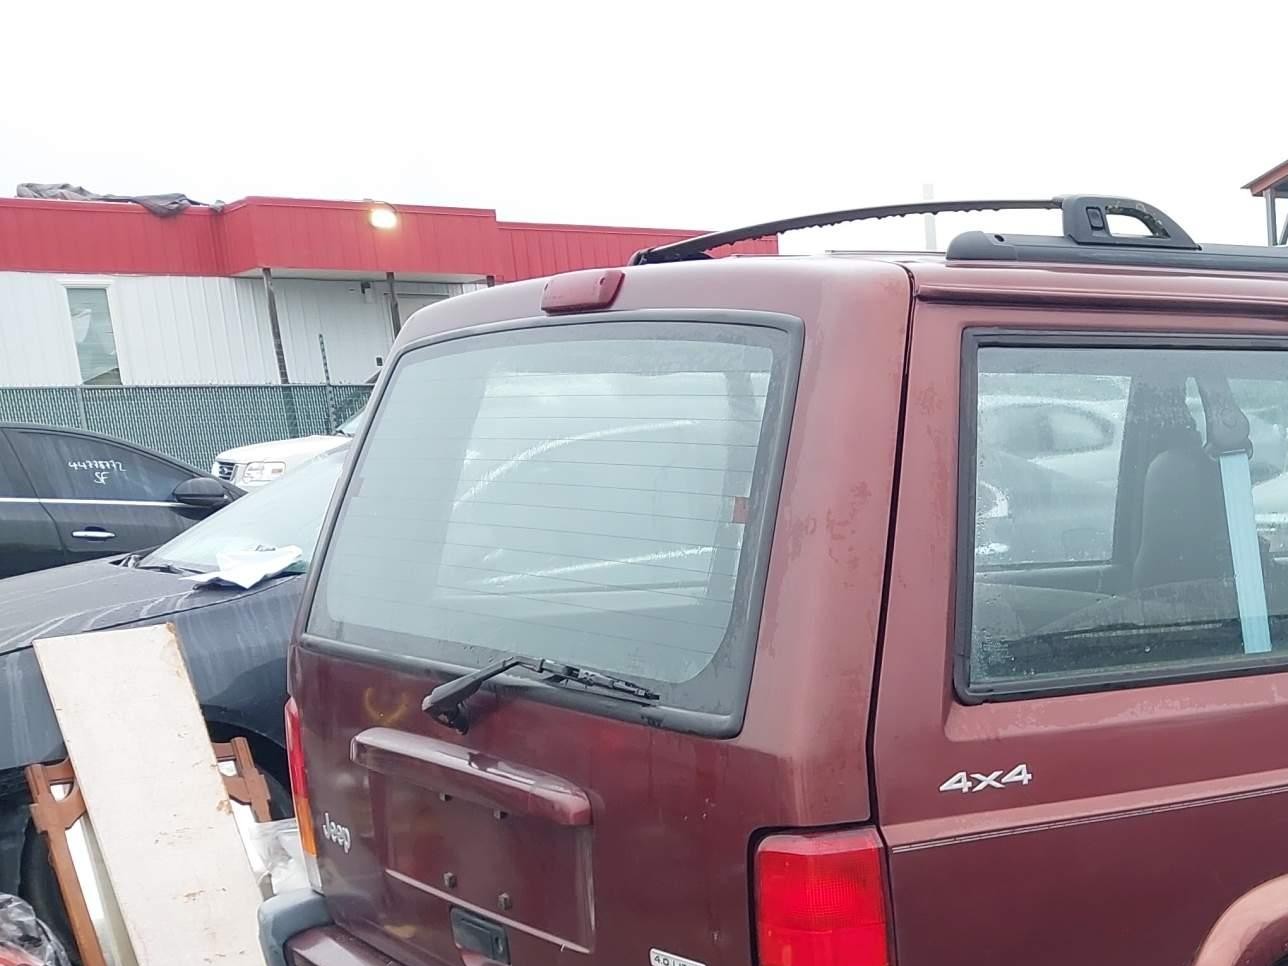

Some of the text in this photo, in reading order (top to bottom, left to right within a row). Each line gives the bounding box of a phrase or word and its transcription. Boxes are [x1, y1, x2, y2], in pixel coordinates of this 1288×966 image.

[93, 471, 110, 485] SF
[322, 812, 351, 854] Jeep
[654, 955, 670, 966] 4.0
